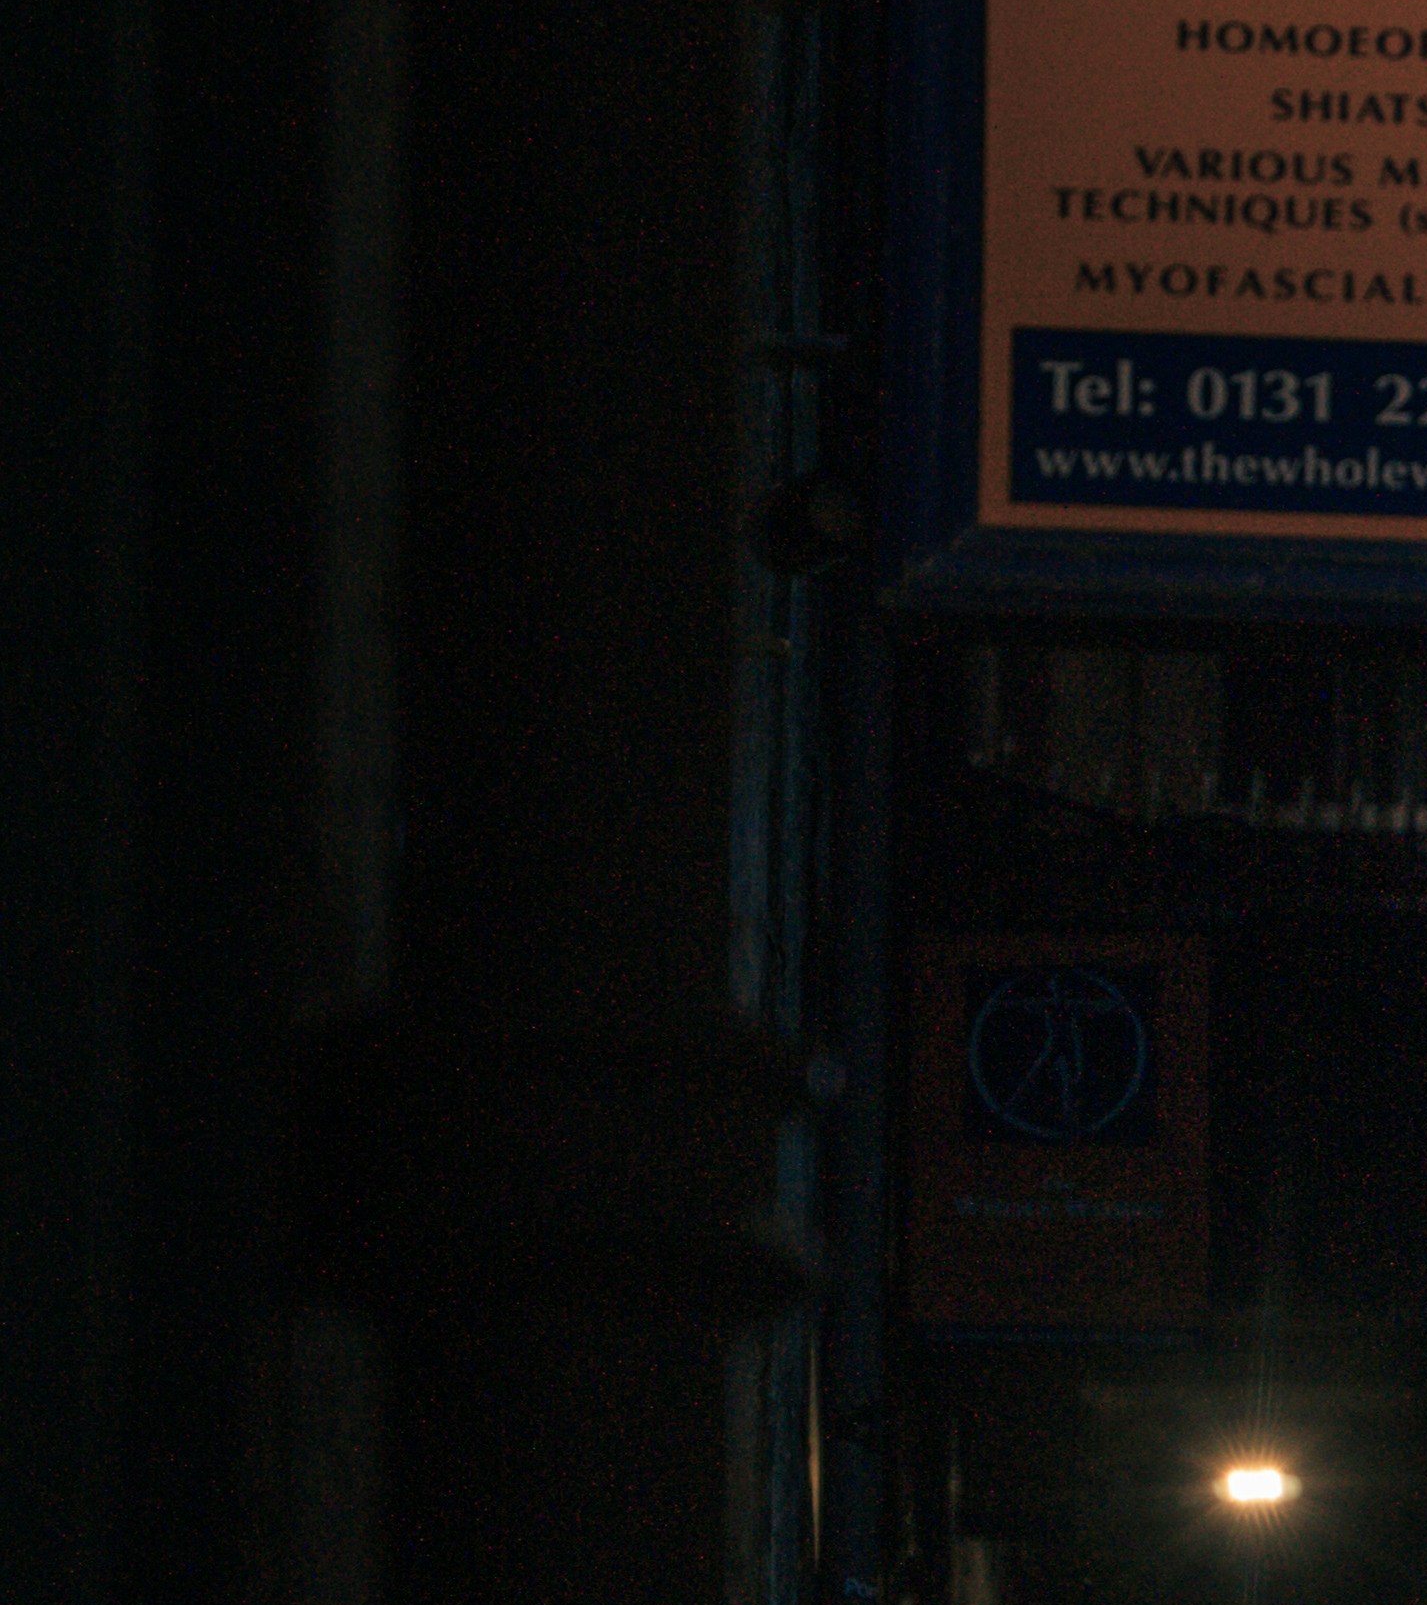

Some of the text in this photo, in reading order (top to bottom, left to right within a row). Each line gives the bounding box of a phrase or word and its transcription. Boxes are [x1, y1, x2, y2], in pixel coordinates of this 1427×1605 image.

[1133, 146, 1353, 188] VARIOUS
[1052, 186, 1373, 233] TECHNIQUES
[1074, 261, 1423, 306] MYOFASCIAL
[1039, 360, 1155, 416] Tel:
[1187, 366, 1333, 424] 0131
